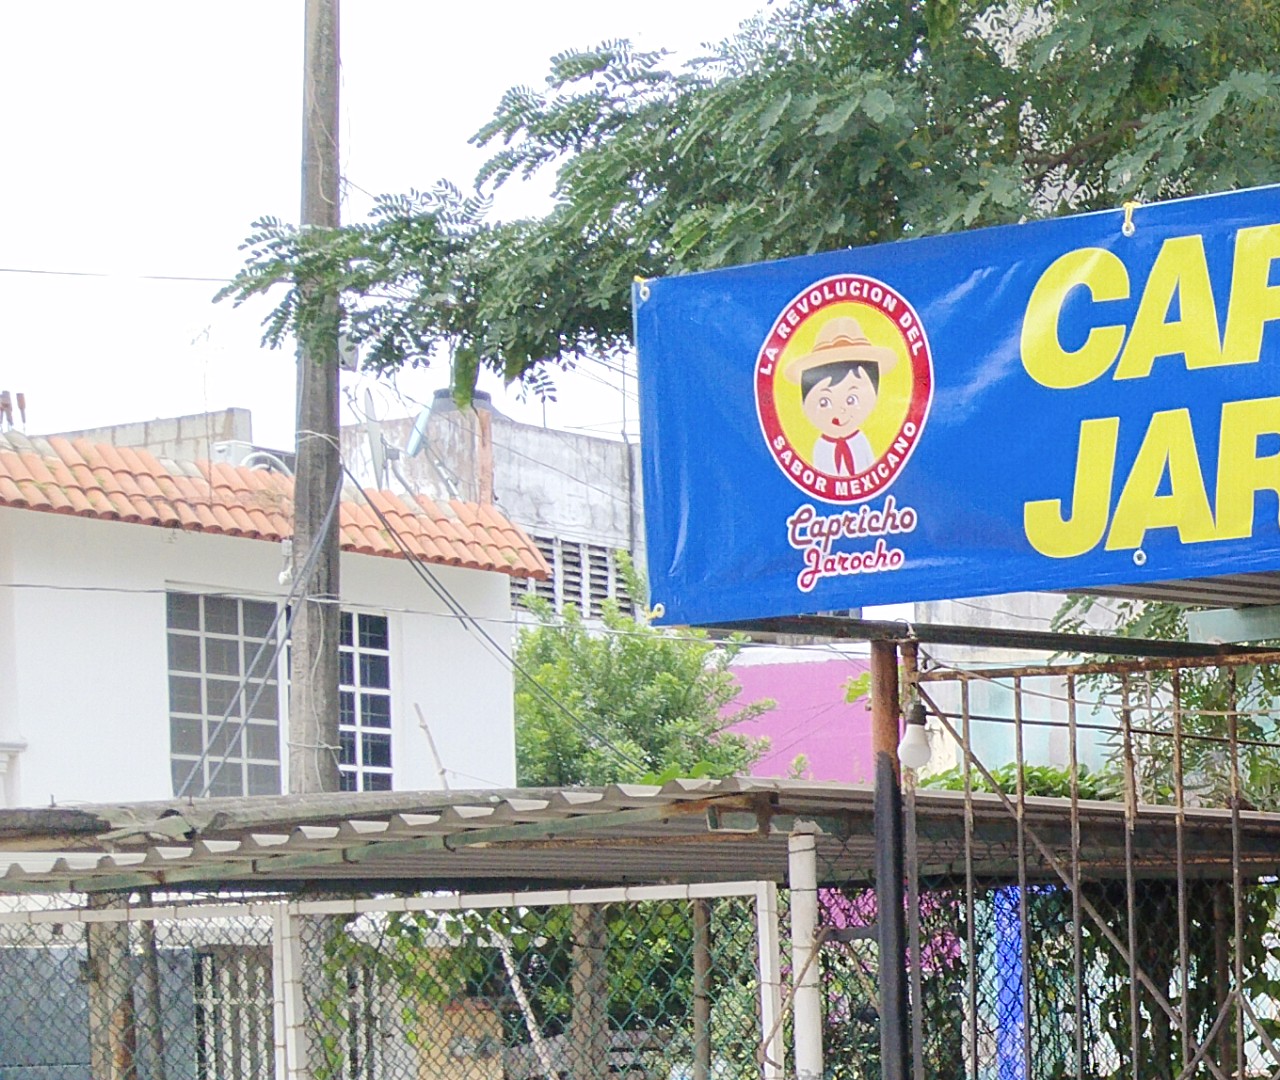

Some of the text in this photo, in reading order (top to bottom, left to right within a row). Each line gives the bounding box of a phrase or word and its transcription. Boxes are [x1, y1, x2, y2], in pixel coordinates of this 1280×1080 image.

[759, 280, 923, 376] LA REVOLUCION DEL
[772, 420, 917, 497] SABOR MEXICANO
[788, 495, 916, 552] Capricho
[798, 539, 903, 591] Jarocho
